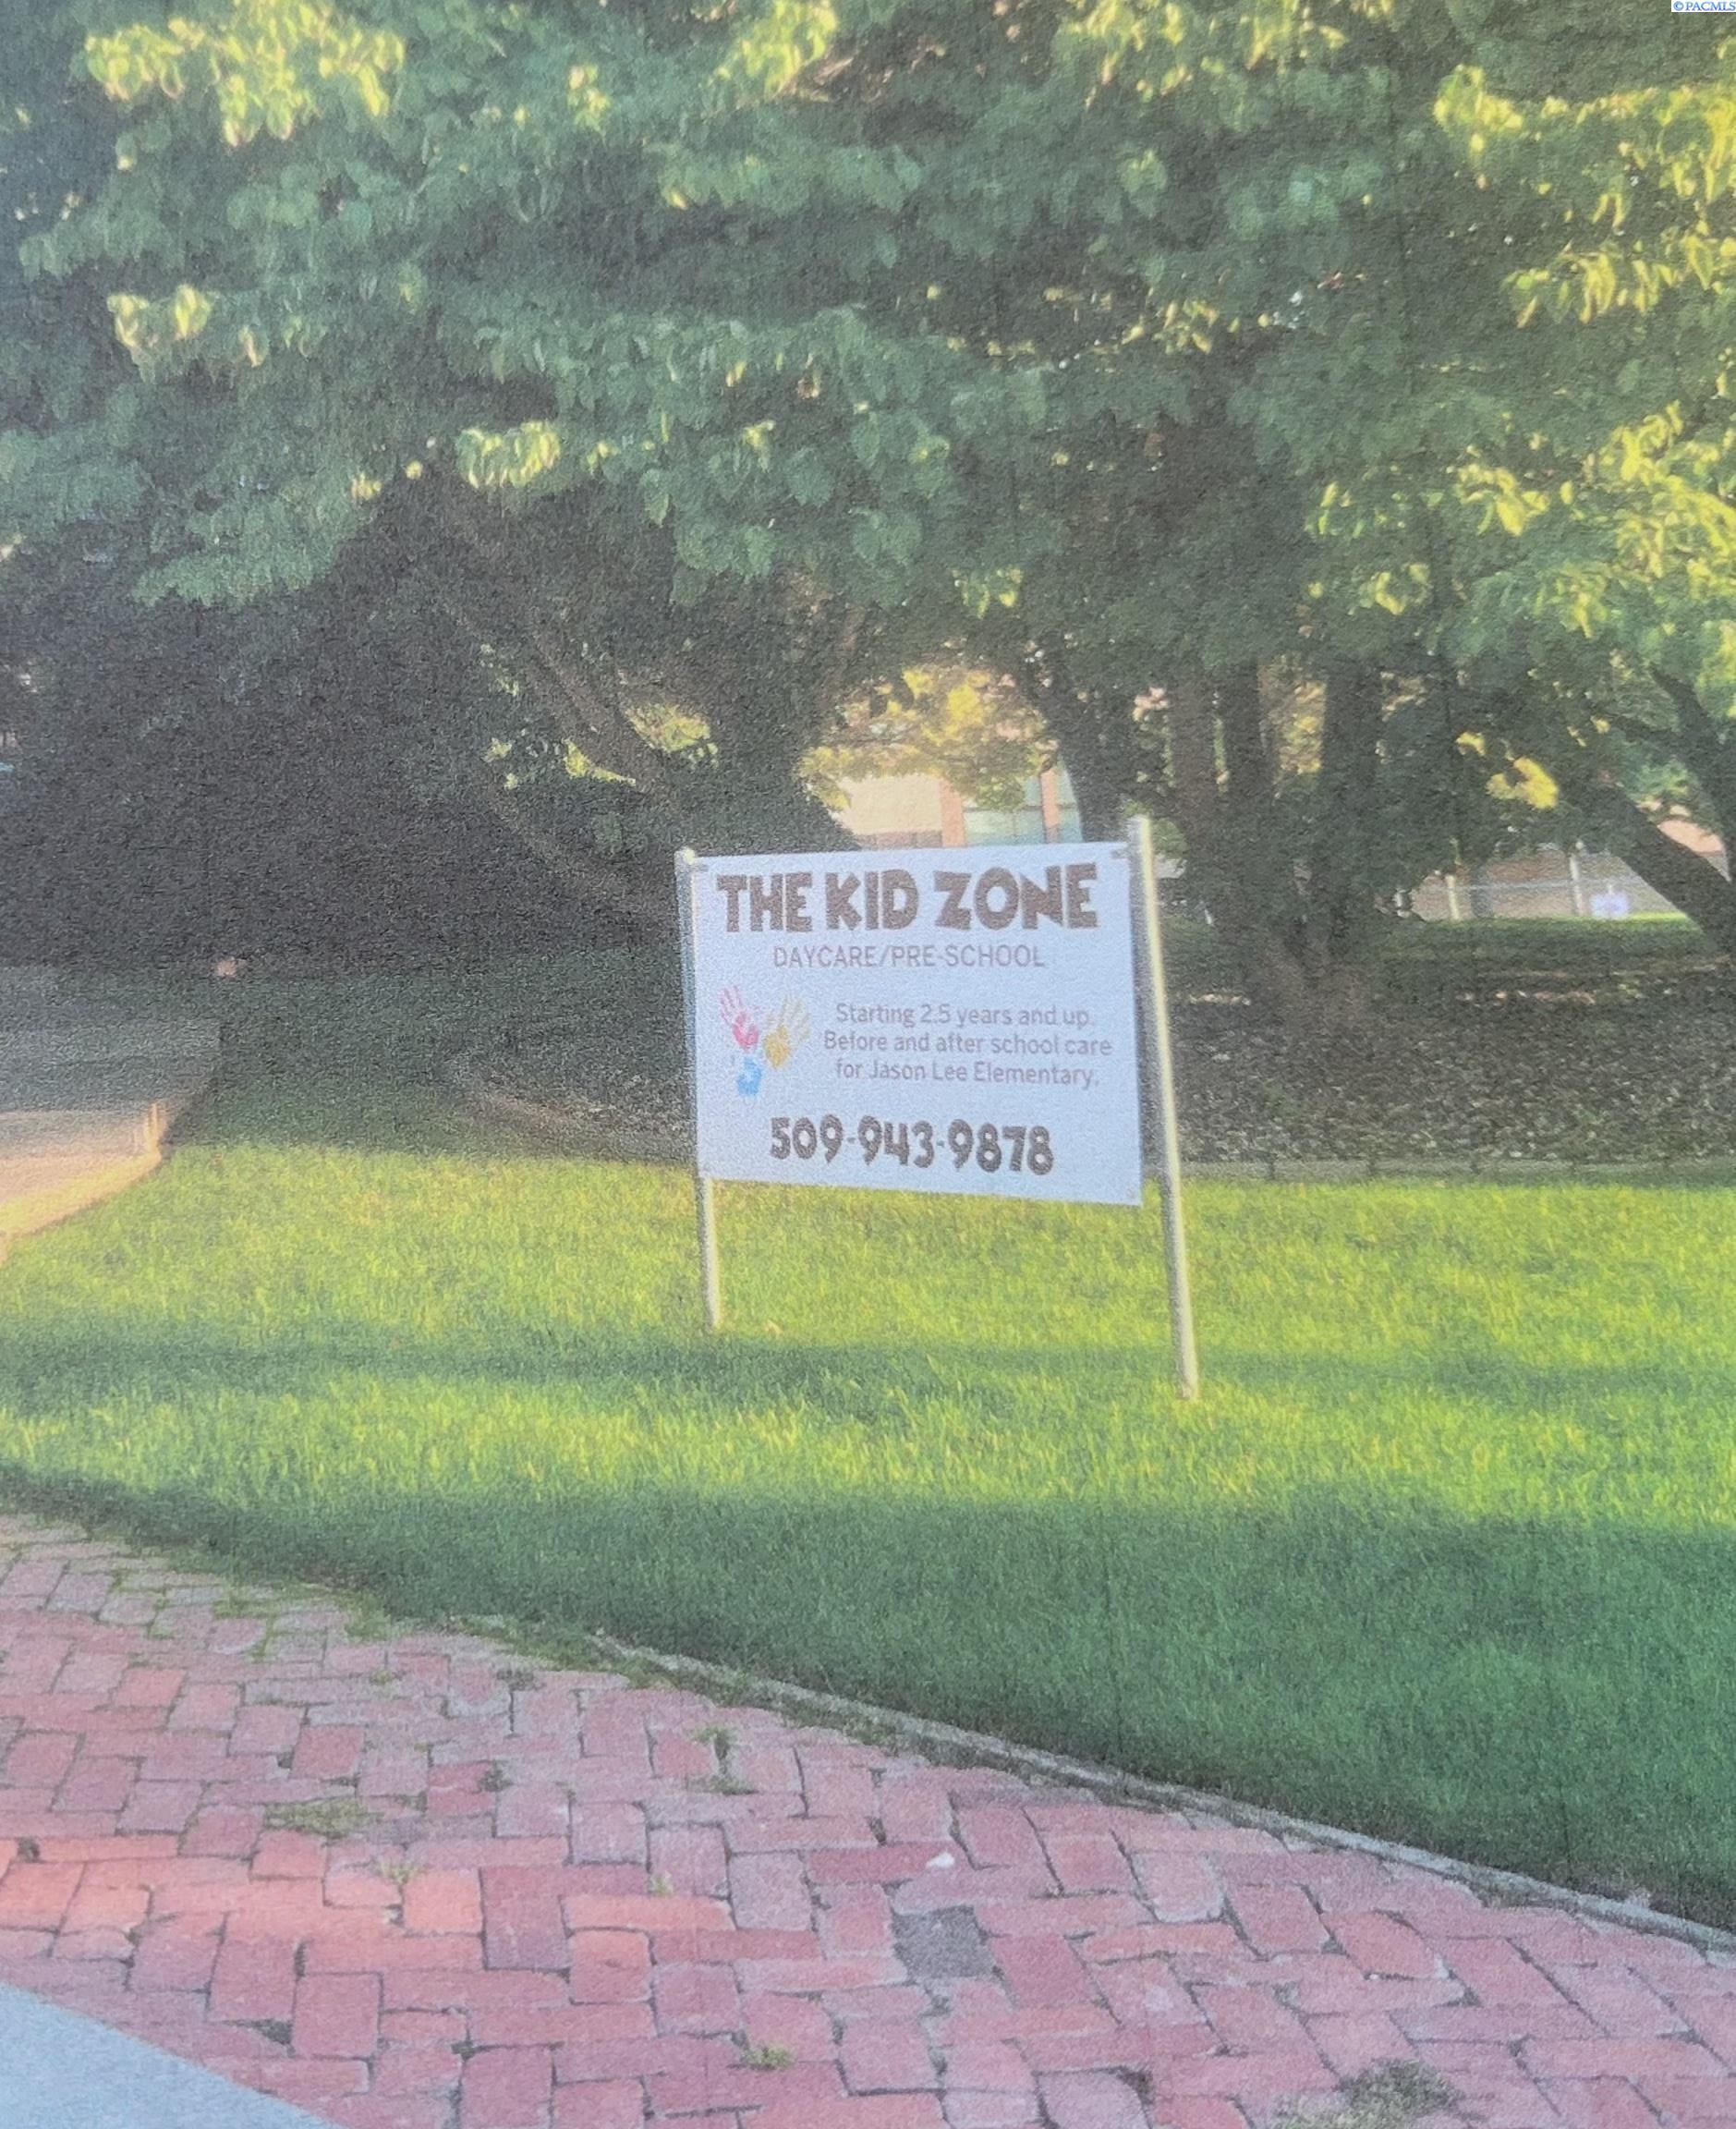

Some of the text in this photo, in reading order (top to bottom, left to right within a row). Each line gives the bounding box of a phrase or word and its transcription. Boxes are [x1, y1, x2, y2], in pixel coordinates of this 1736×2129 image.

[716, 862, 1099, 932] THE KID ZONE
[773, 944, 1046, 968] DAYCARE/PRE-SCHOOL
[836, 1003, 916, 1028] Starting
[920, 1004, 951, 1024] 2.5
[955, 1008, 1013, 1028] years
[1017, 1004, 1057, 1026] and
[824, 1030, 1113, 1056] Before and after school care
[836, 1059, 863, 1079] for
[870, 1061, 925, 1081] Jason
[932, 1062, 967, 1082] Lee
[769, 1114, 1054, 1175] 509-943-9878
